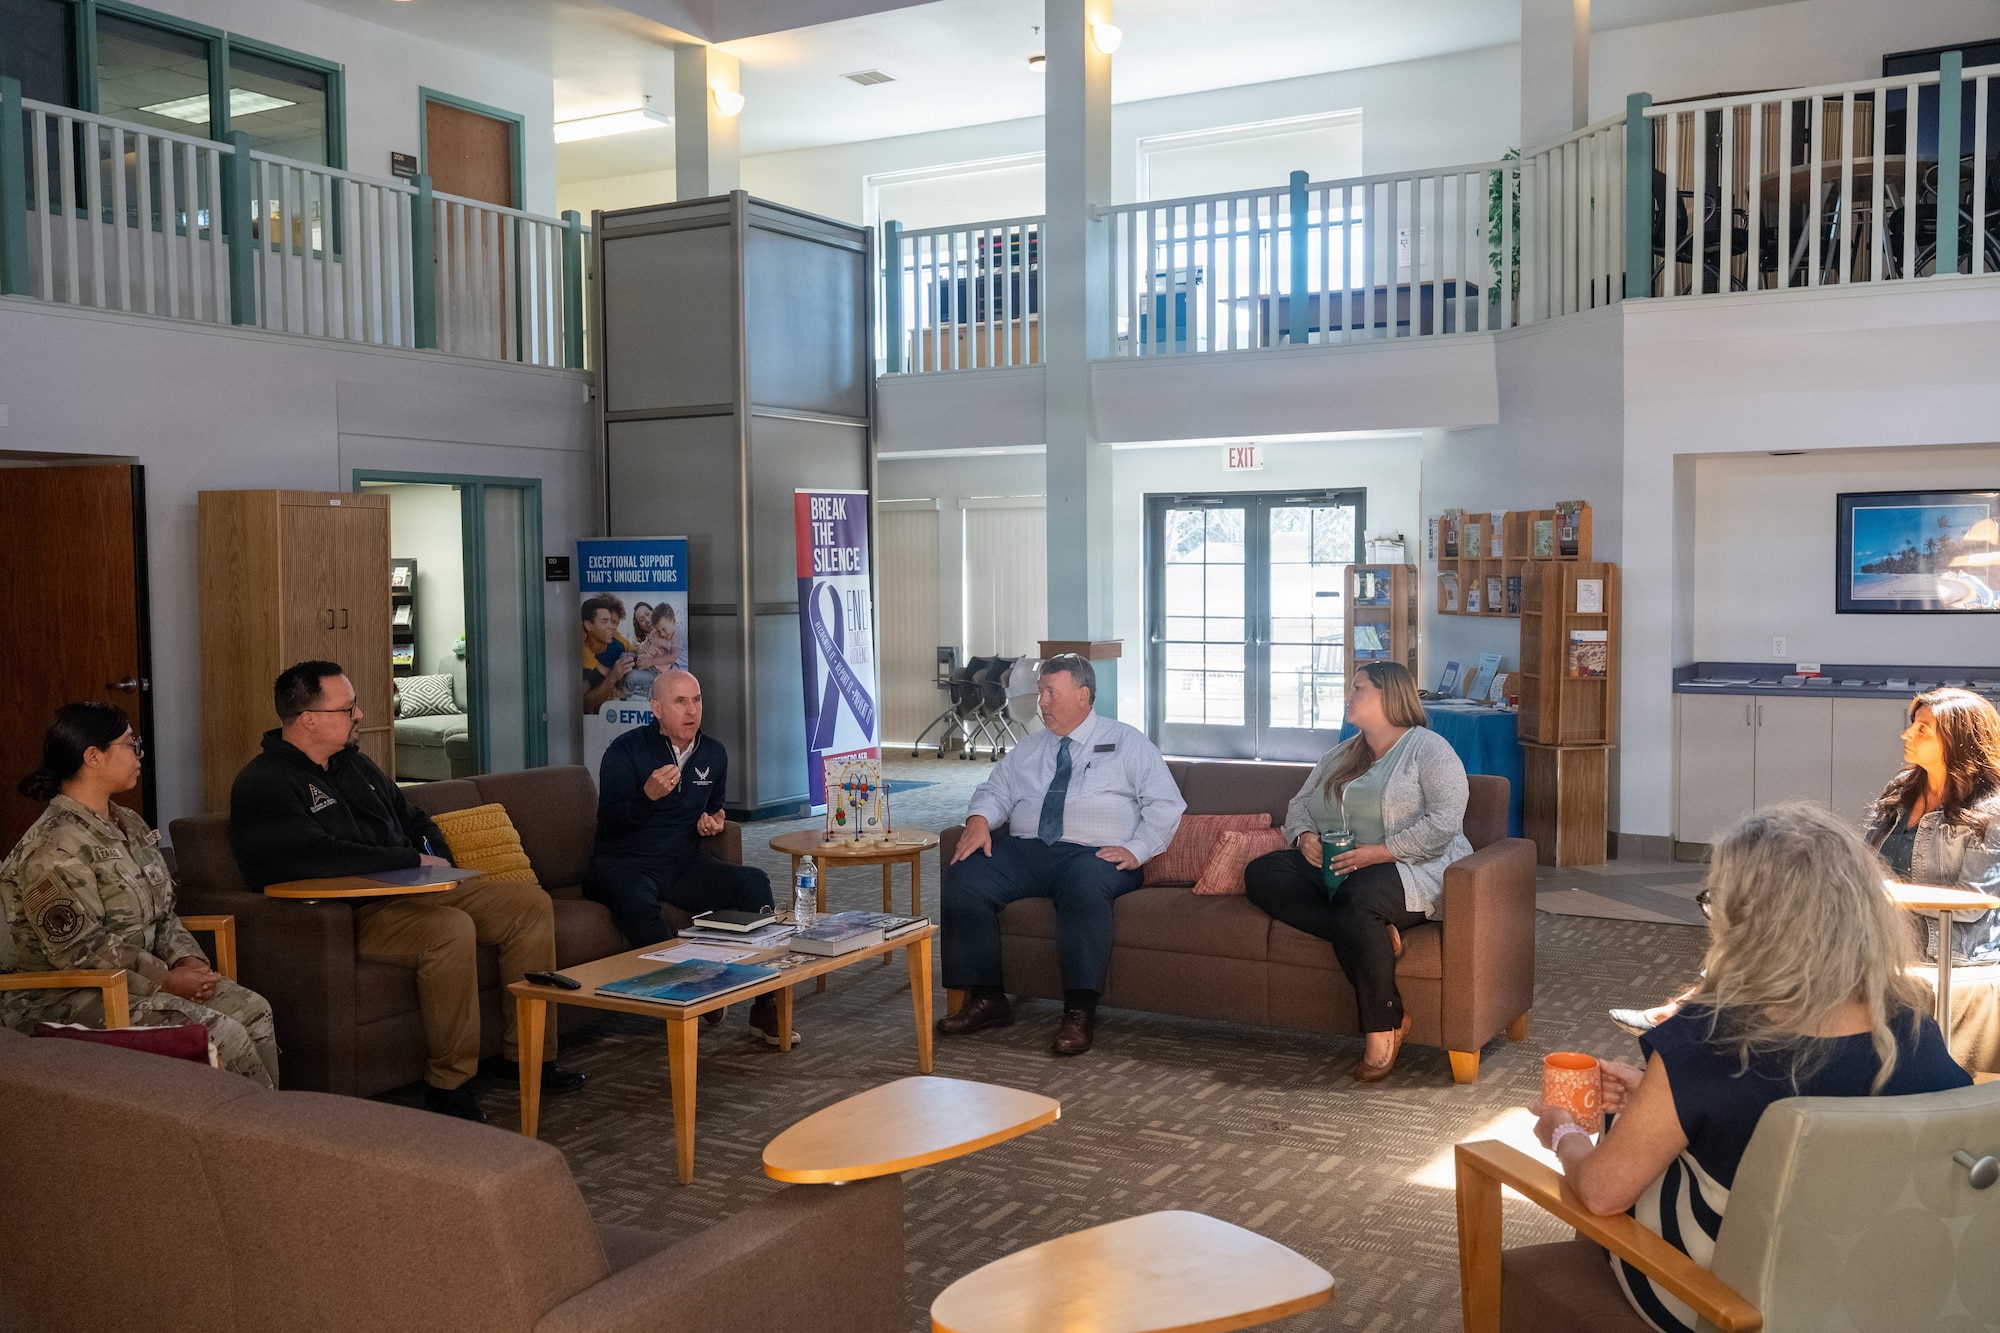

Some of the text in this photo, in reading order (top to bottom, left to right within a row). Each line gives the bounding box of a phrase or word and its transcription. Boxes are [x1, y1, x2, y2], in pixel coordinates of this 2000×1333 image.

[1229, 447, 1255, 468] EXIT
[810, 497, 847, 520] BREAK
[812, 522, 835, 546] THE
[588, 555, 675, 568] EXCEPTIONAL SUPPORT
[813, 547, 861, 573] SILENCE
[586, 570, 678, 583] THAT'S UNIQUELY YOURS
[847, 590, 868, 631] END
[814, 621, 833, 654] RECOGNIZE
[834, 661, 851, 687] REPORT
[1583, 1089, 1595, 1109] C
